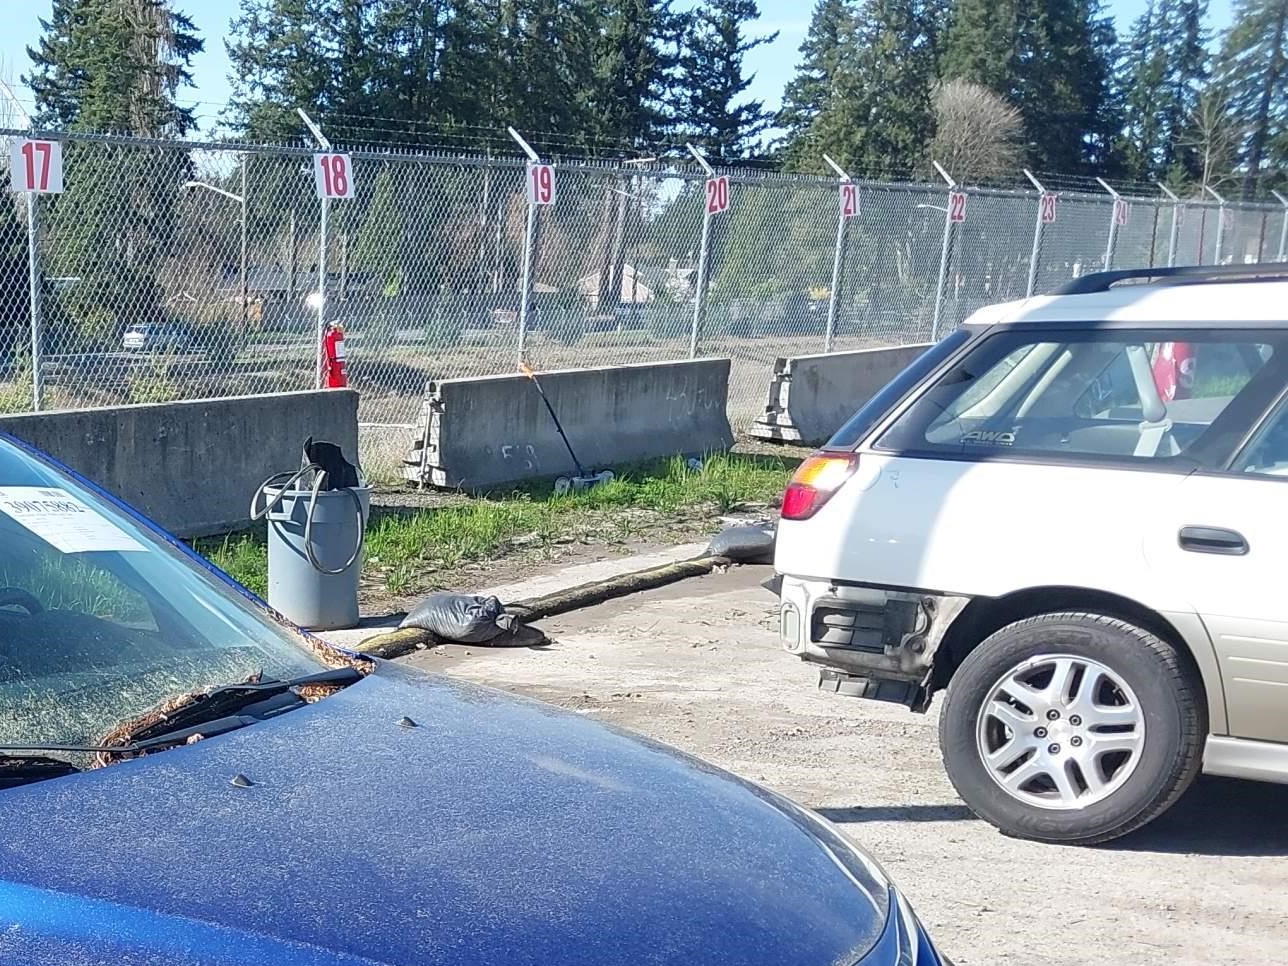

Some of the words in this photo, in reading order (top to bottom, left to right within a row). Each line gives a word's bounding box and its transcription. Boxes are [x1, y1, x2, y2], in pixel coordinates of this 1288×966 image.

[22, 142, 52, 190] 17
[321, 155, 348, 196] 18
[532, 166, 552, 202] 19
[708, 177, 727, 213] 20
[843, 186, 857, 215] 21
[951, 194, 965, 220] 22
[1042, 197, 1054, 221] 23
